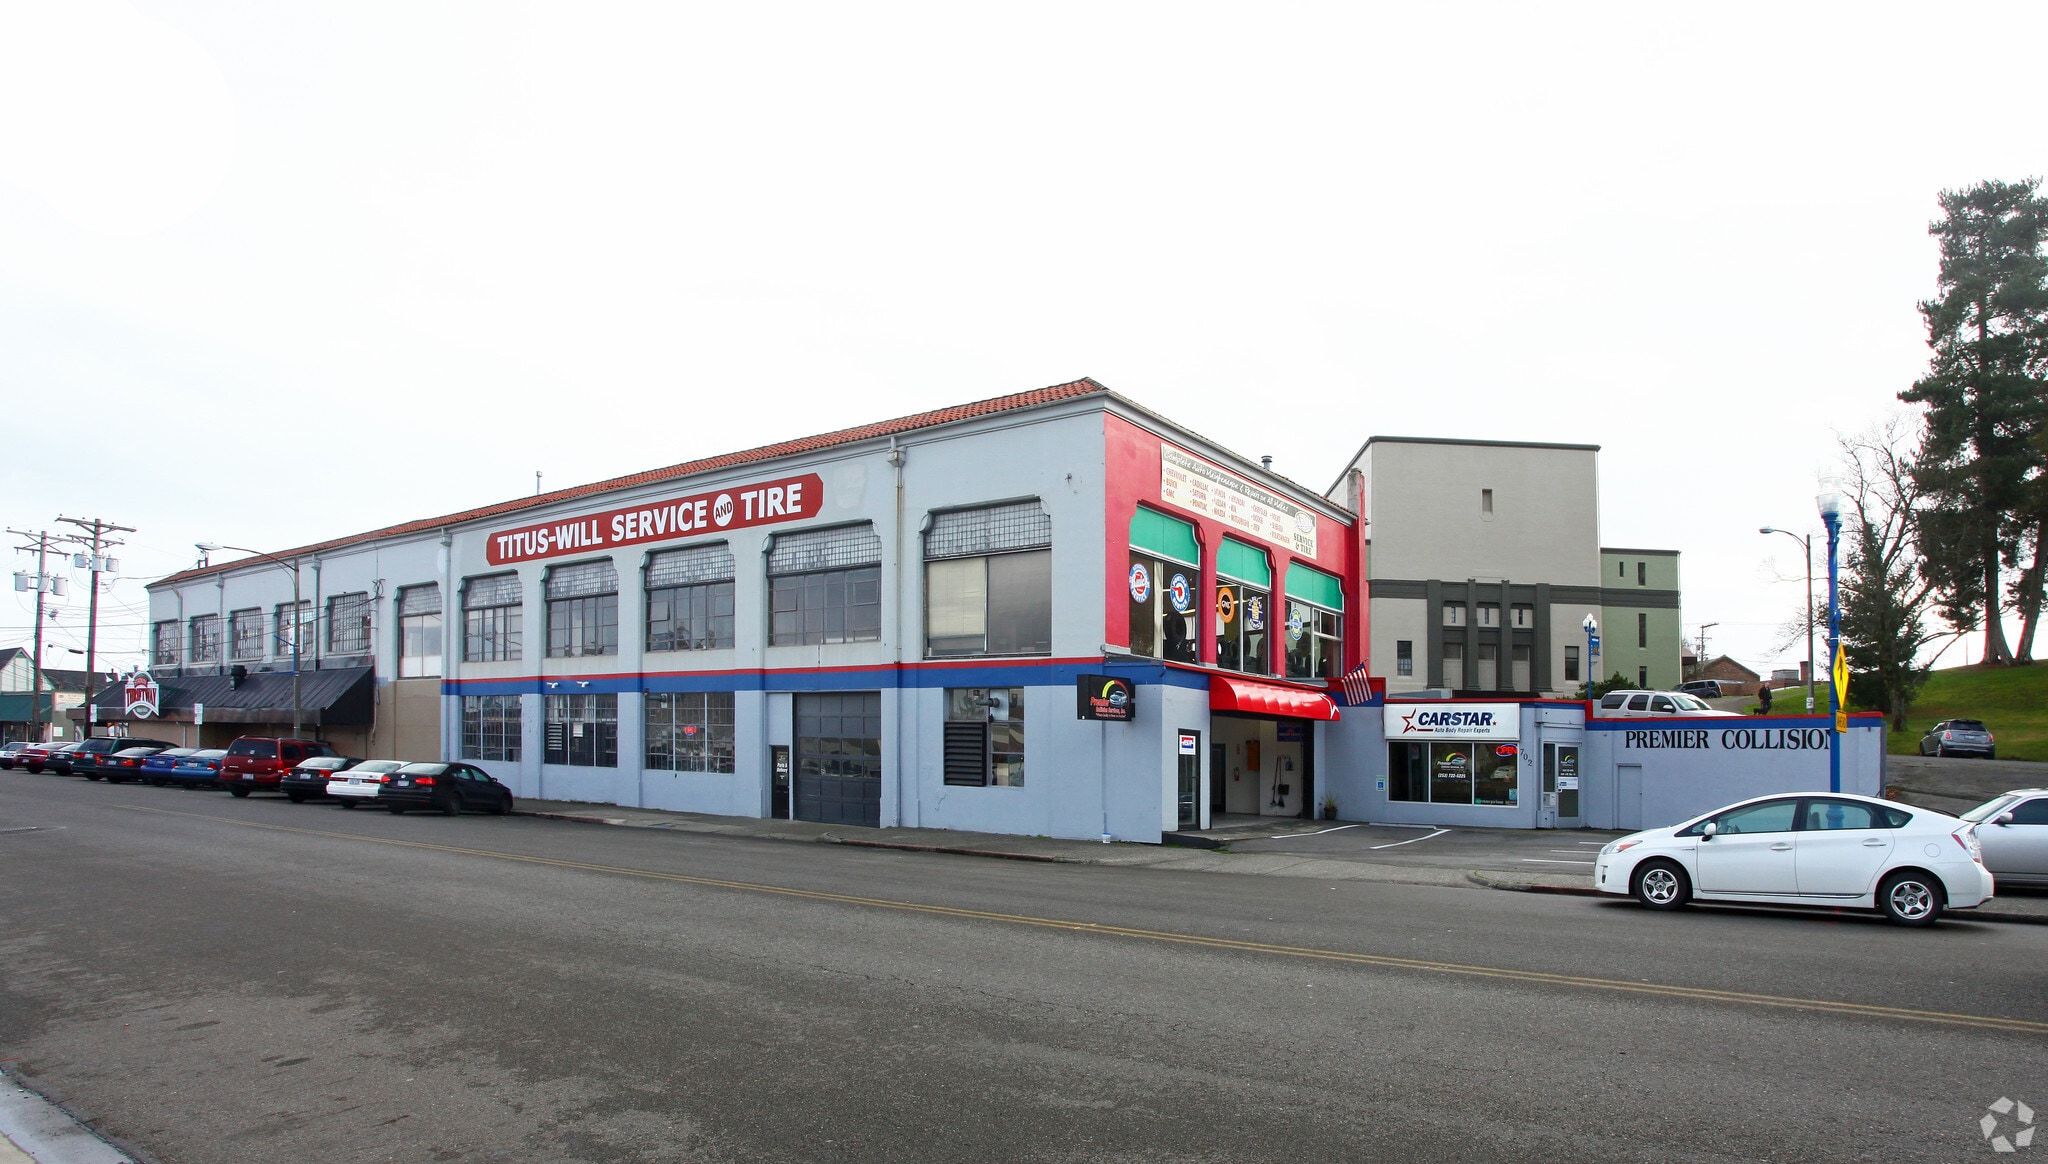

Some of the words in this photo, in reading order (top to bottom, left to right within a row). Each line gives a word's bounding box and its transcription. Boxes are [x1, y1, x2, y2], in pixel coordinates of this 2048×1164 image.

[1191, 462, 1205, 475] Auto
[497, 518, 603, 560] TITUS-WILL
[611, 499, 708, 542] SERVICE
[715, 501, 732, 520] AND
[740, 482, 803, 521] TIRE
[1293, 532, 1314, 548] SERVICE
[1300, 544, 1312, 555] TIRE
[1418, 712, 1493, 726] CARSTAR
[1625, 730, 1710, 749] PREMIER
[1495, 744, 1518, 755] OPEN
